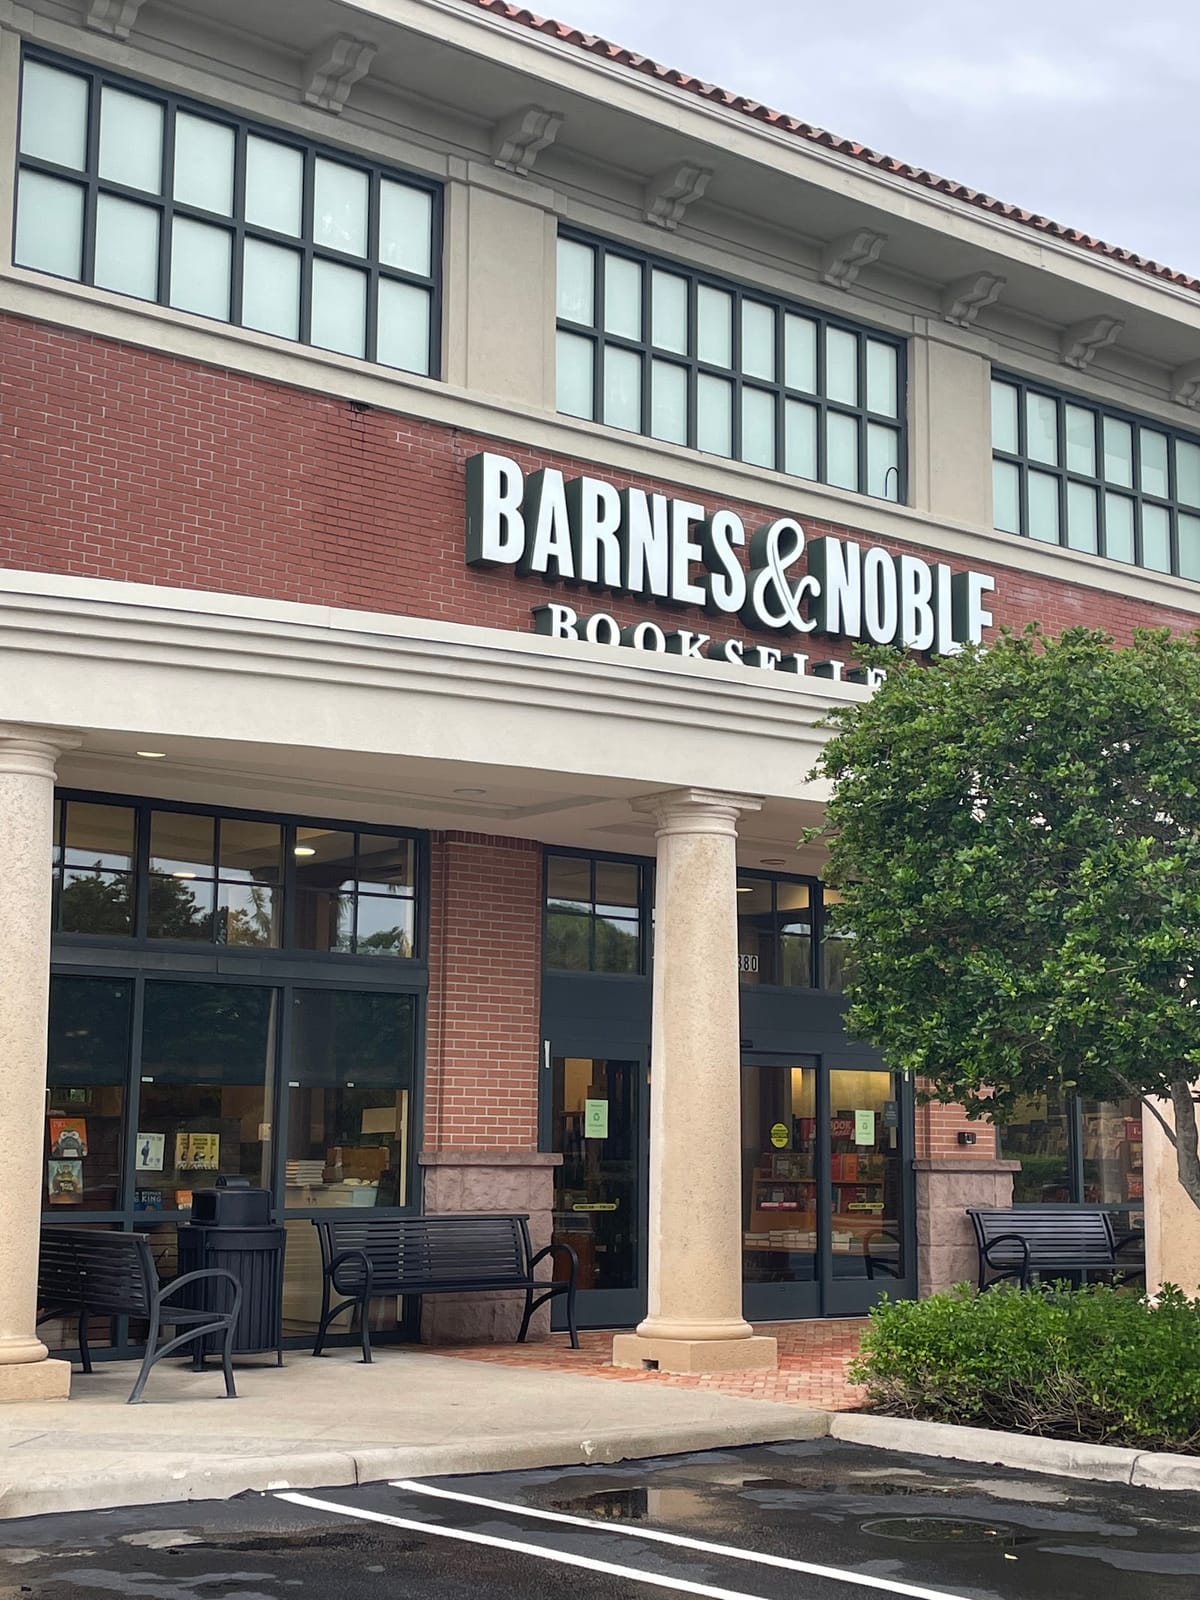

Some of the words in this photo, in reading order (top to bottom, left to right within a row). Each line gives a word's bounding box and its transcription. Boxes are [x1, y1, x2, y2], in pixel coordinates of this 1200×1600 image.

[482, 452, 747, 613] BARNES
[753, 517, 821, 632] &
[825, 536, 995, 660] NOBLE
